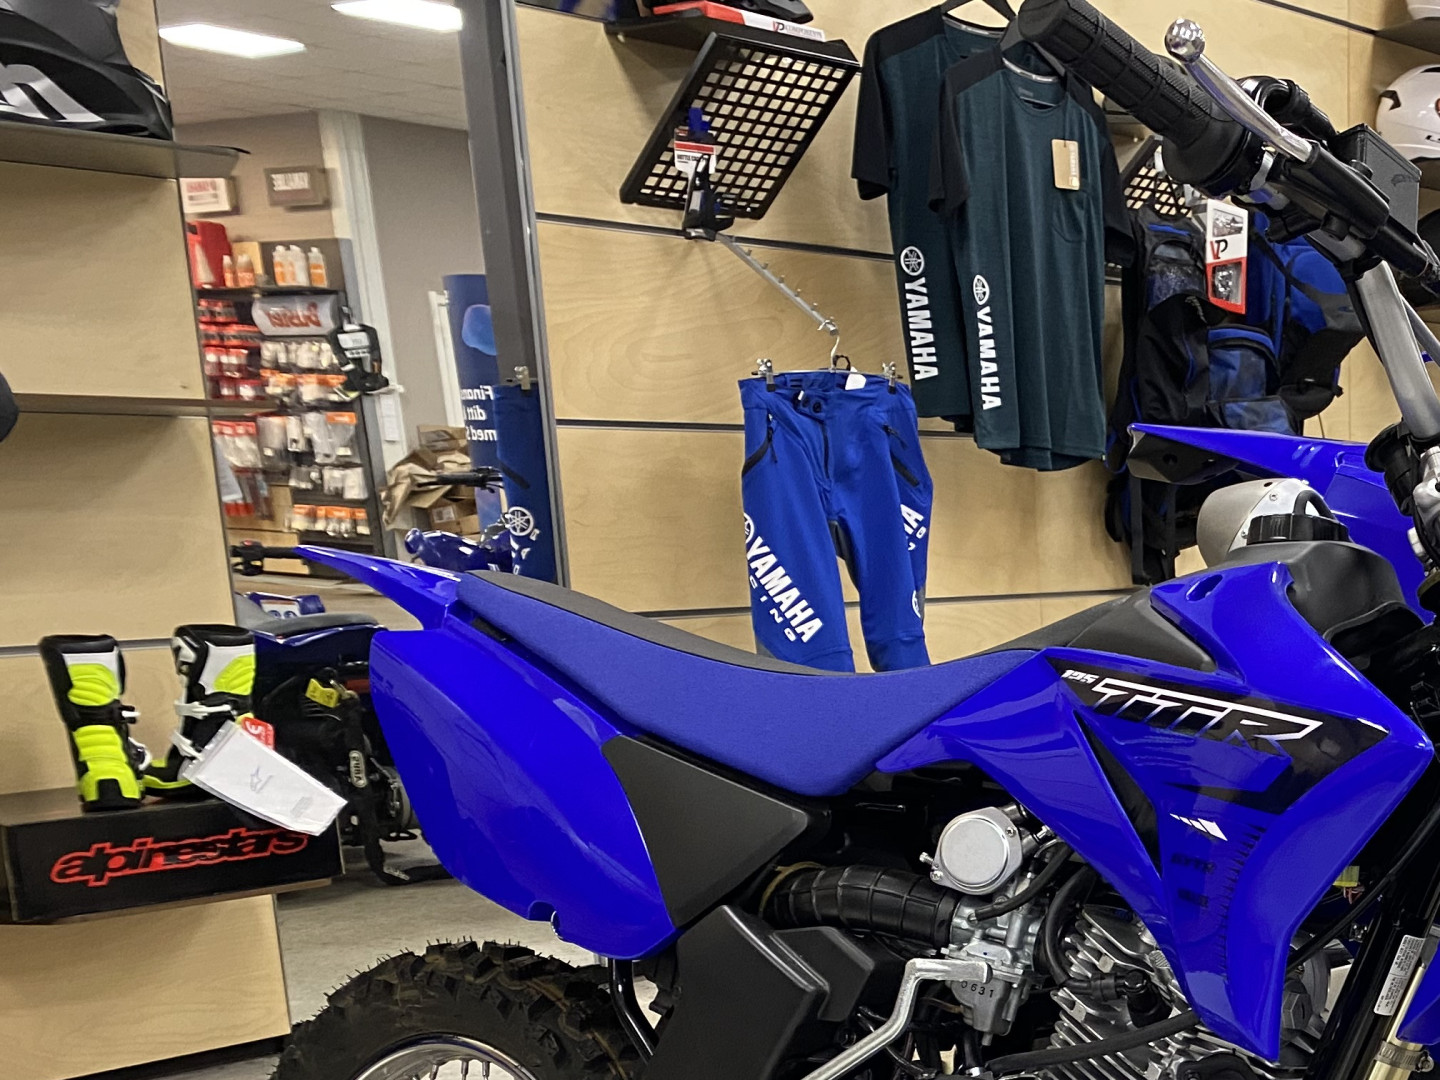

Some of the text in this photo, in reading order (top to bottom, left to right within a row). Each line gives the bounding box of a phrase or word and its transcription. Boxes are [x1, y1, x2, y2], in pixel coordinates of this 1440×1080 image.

[1209, 238, 1229, 261] VP
[904, 276, 939, 381] YAMAHA
[976, 305, 1002, 411] YAMAHA
[746, 535, 823, 643] YAMAHA
[1061, 669, 1099, 685] 125
[50, 826, 310, 888] alpinestars
[960, 980, 994, 998] 0631
